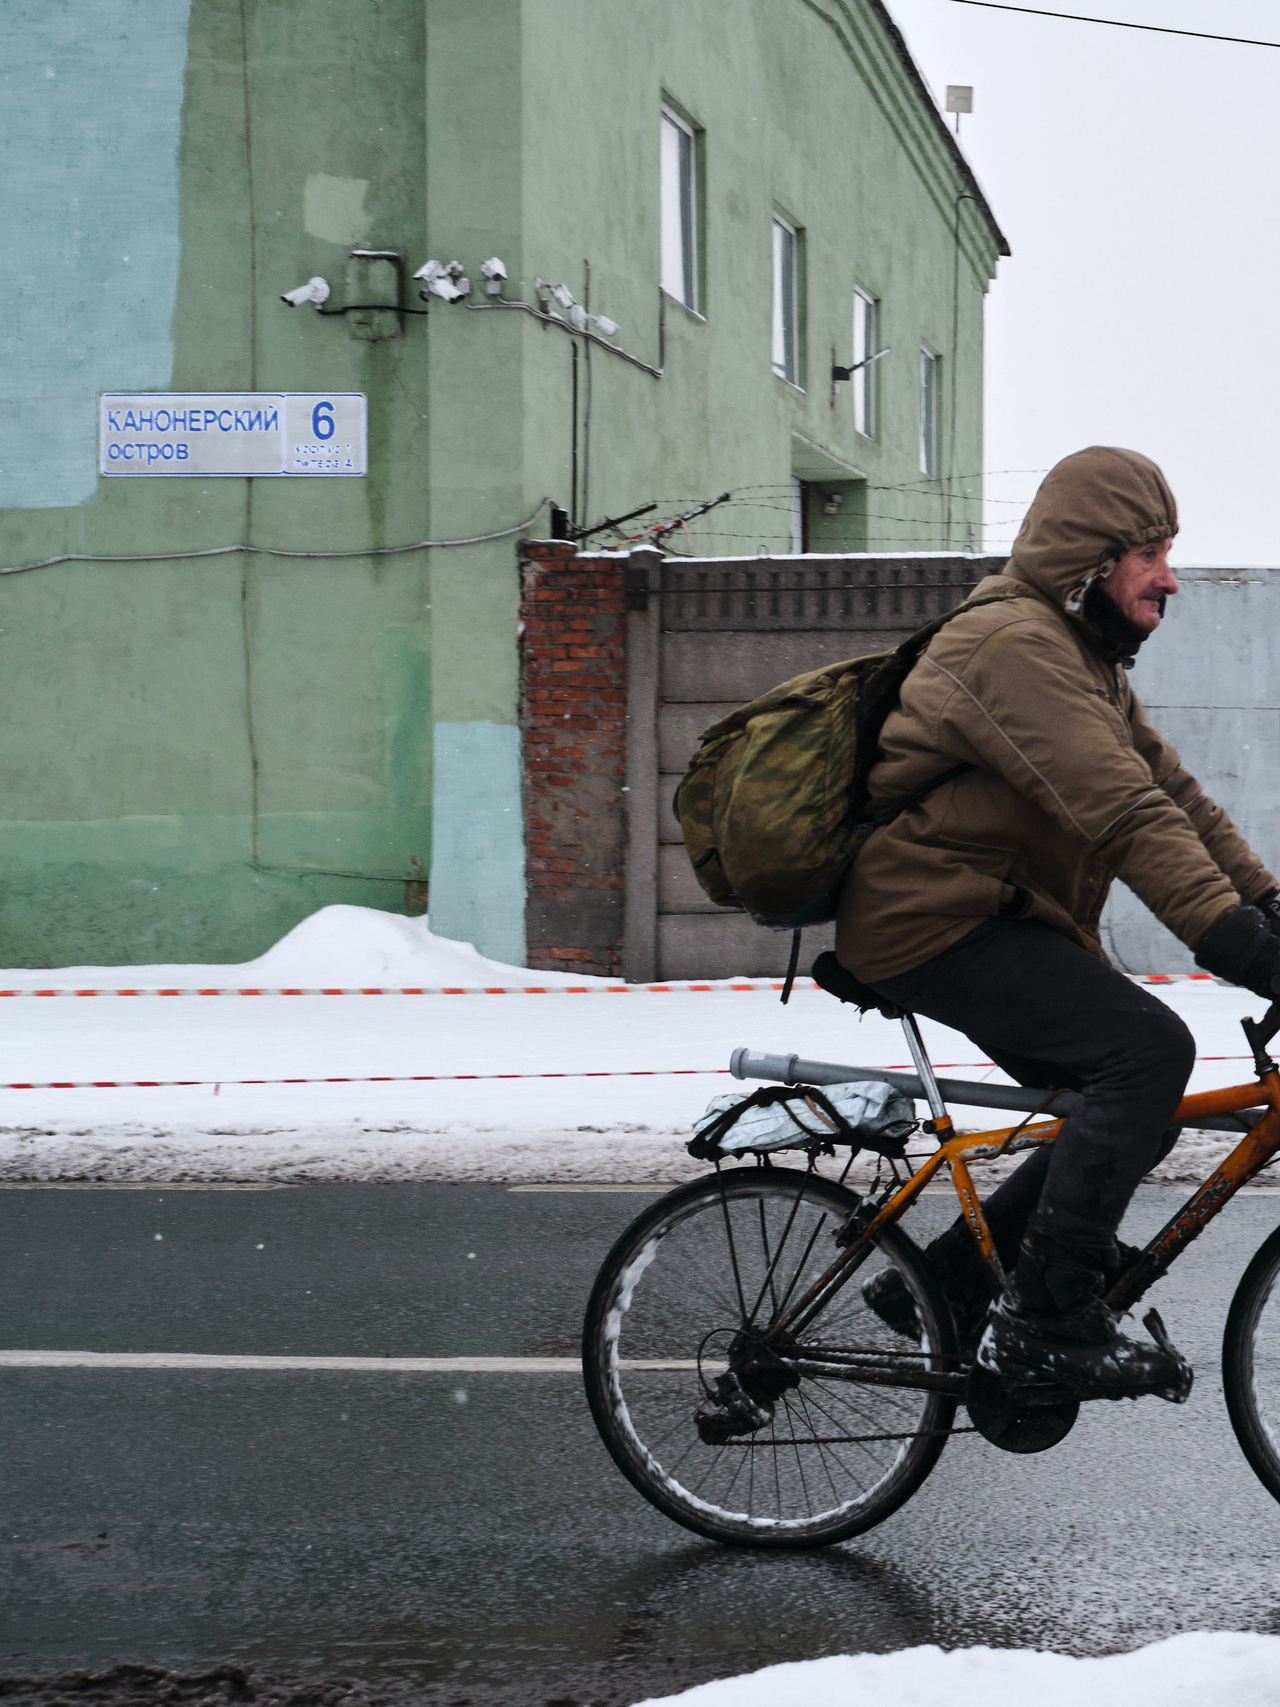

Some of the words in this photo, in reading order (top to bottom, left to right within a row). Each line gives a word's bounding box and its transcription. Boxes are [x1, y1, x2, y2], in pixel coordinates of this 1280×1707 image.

[107, 404, 280, 432] КАНОНЕРСКИЙ
[311, 401, 336, 440] 6
[107, 442, 189, 465] остров
